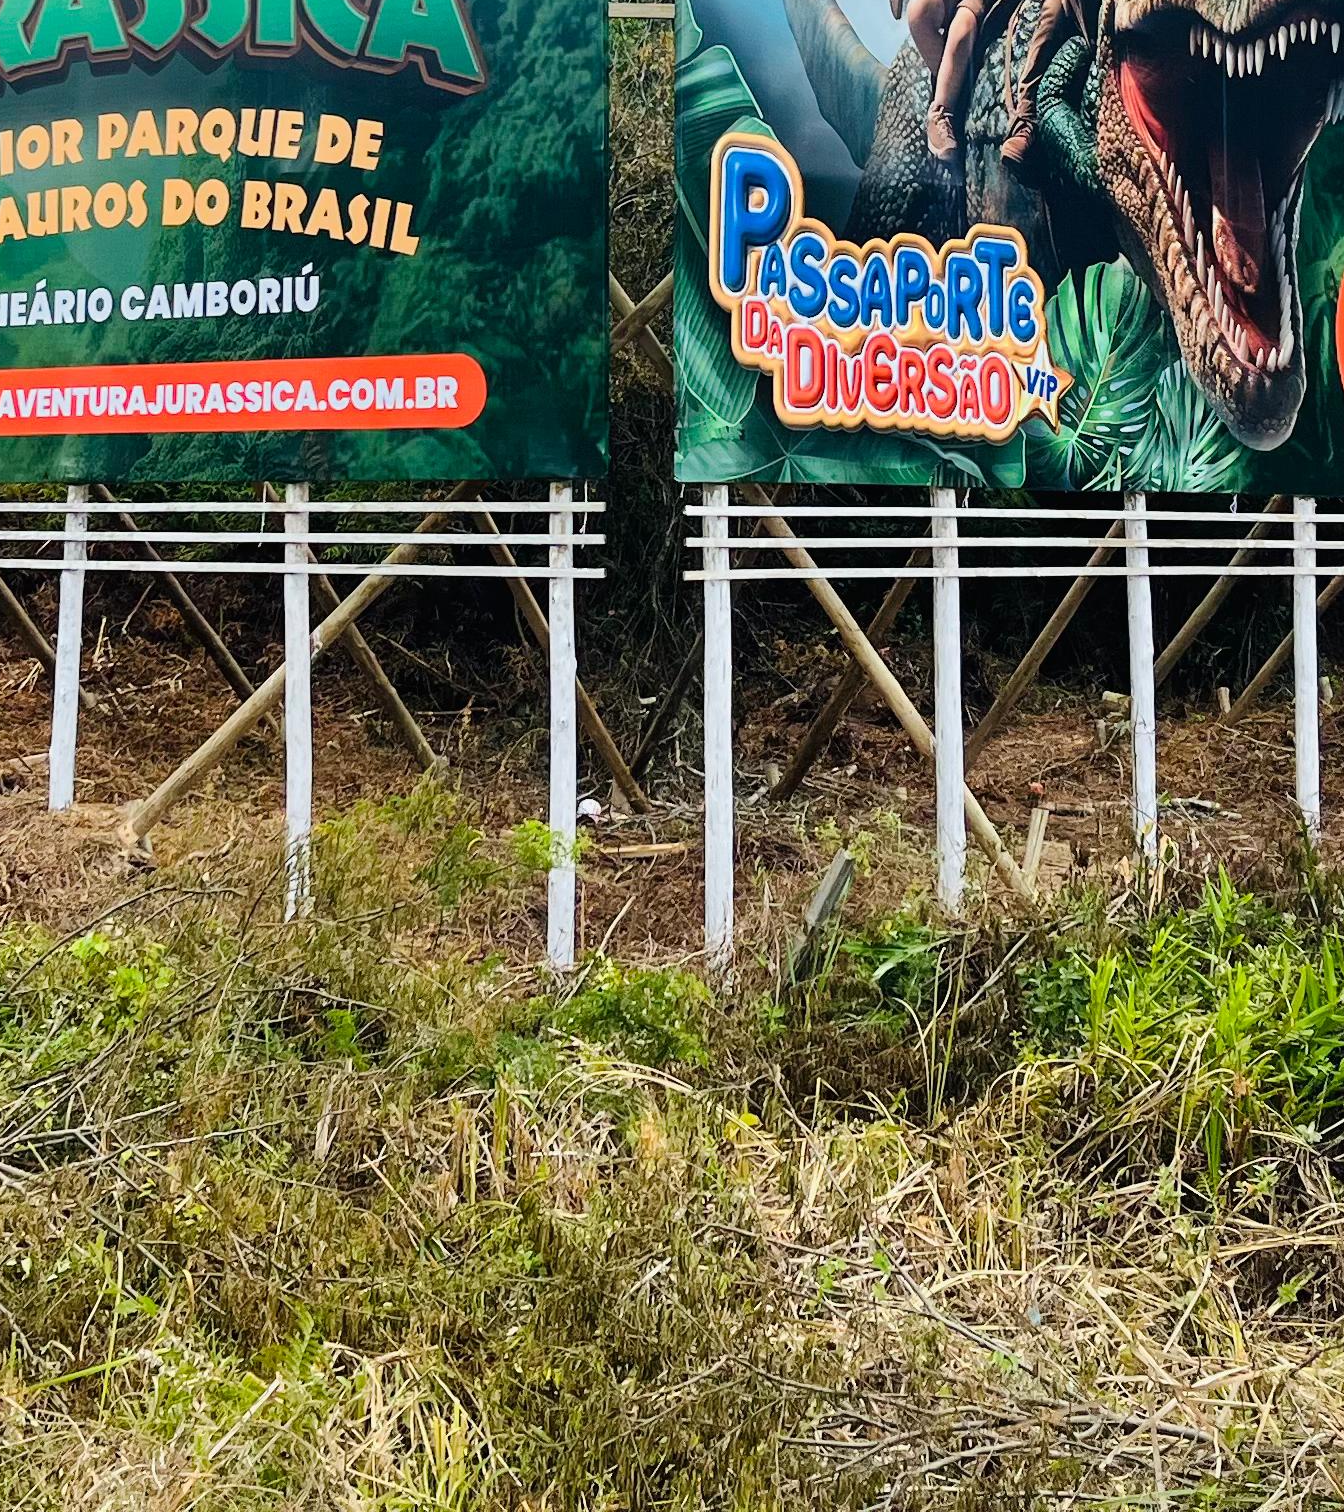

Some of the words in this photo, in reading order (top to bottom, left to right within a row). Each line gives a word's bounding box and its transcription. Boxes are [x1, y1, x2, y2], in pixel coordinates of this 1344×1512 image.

[98, 108, 304, 172] PARQUE
[314, 115, 383, 171] DE
[163, 181, 227, 227] DO
[241, 181, 420, 256] BRASIL
[120, 264, 321, 320] CAMBORIÚ
[745, 300, 783, 358] DA
